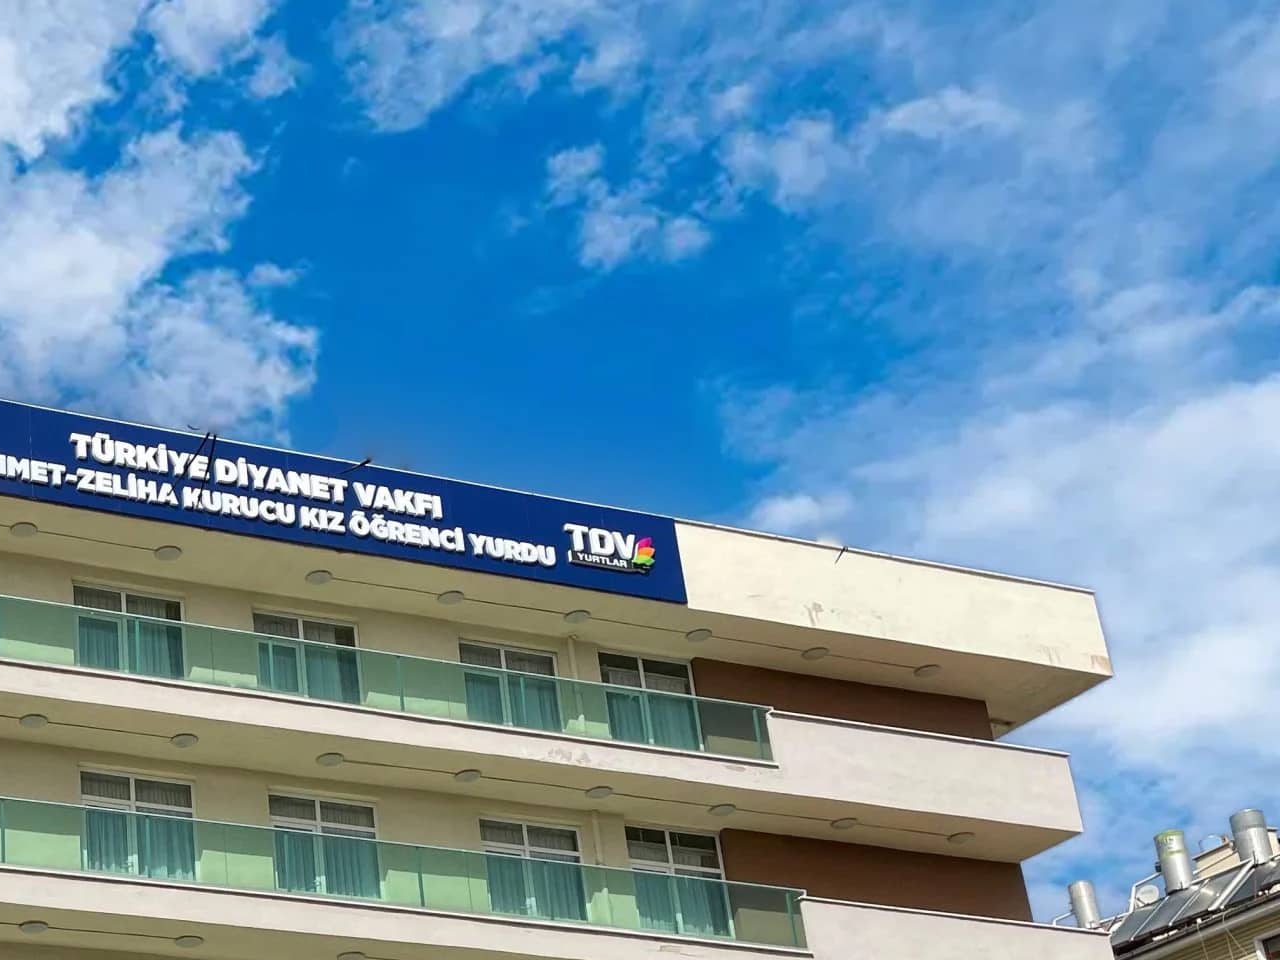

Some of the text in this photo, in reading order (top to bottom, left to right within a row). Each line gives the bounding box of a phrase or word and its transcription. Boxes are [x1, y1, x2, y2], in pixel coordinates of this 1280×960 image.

[70, 432, 443, 520] TÜRKİYE DİYANET VAKFI
[182, 486, 296, 525] KURUCU
[299, 506, 347, 535] KIZ
[349, 510, 465, 552] ÖĞRENCİ
[468, 533, 557, 568] YURDU
[563, 523, 635, 560] TDV
[576, 552, 628, 568] YURTLAR
